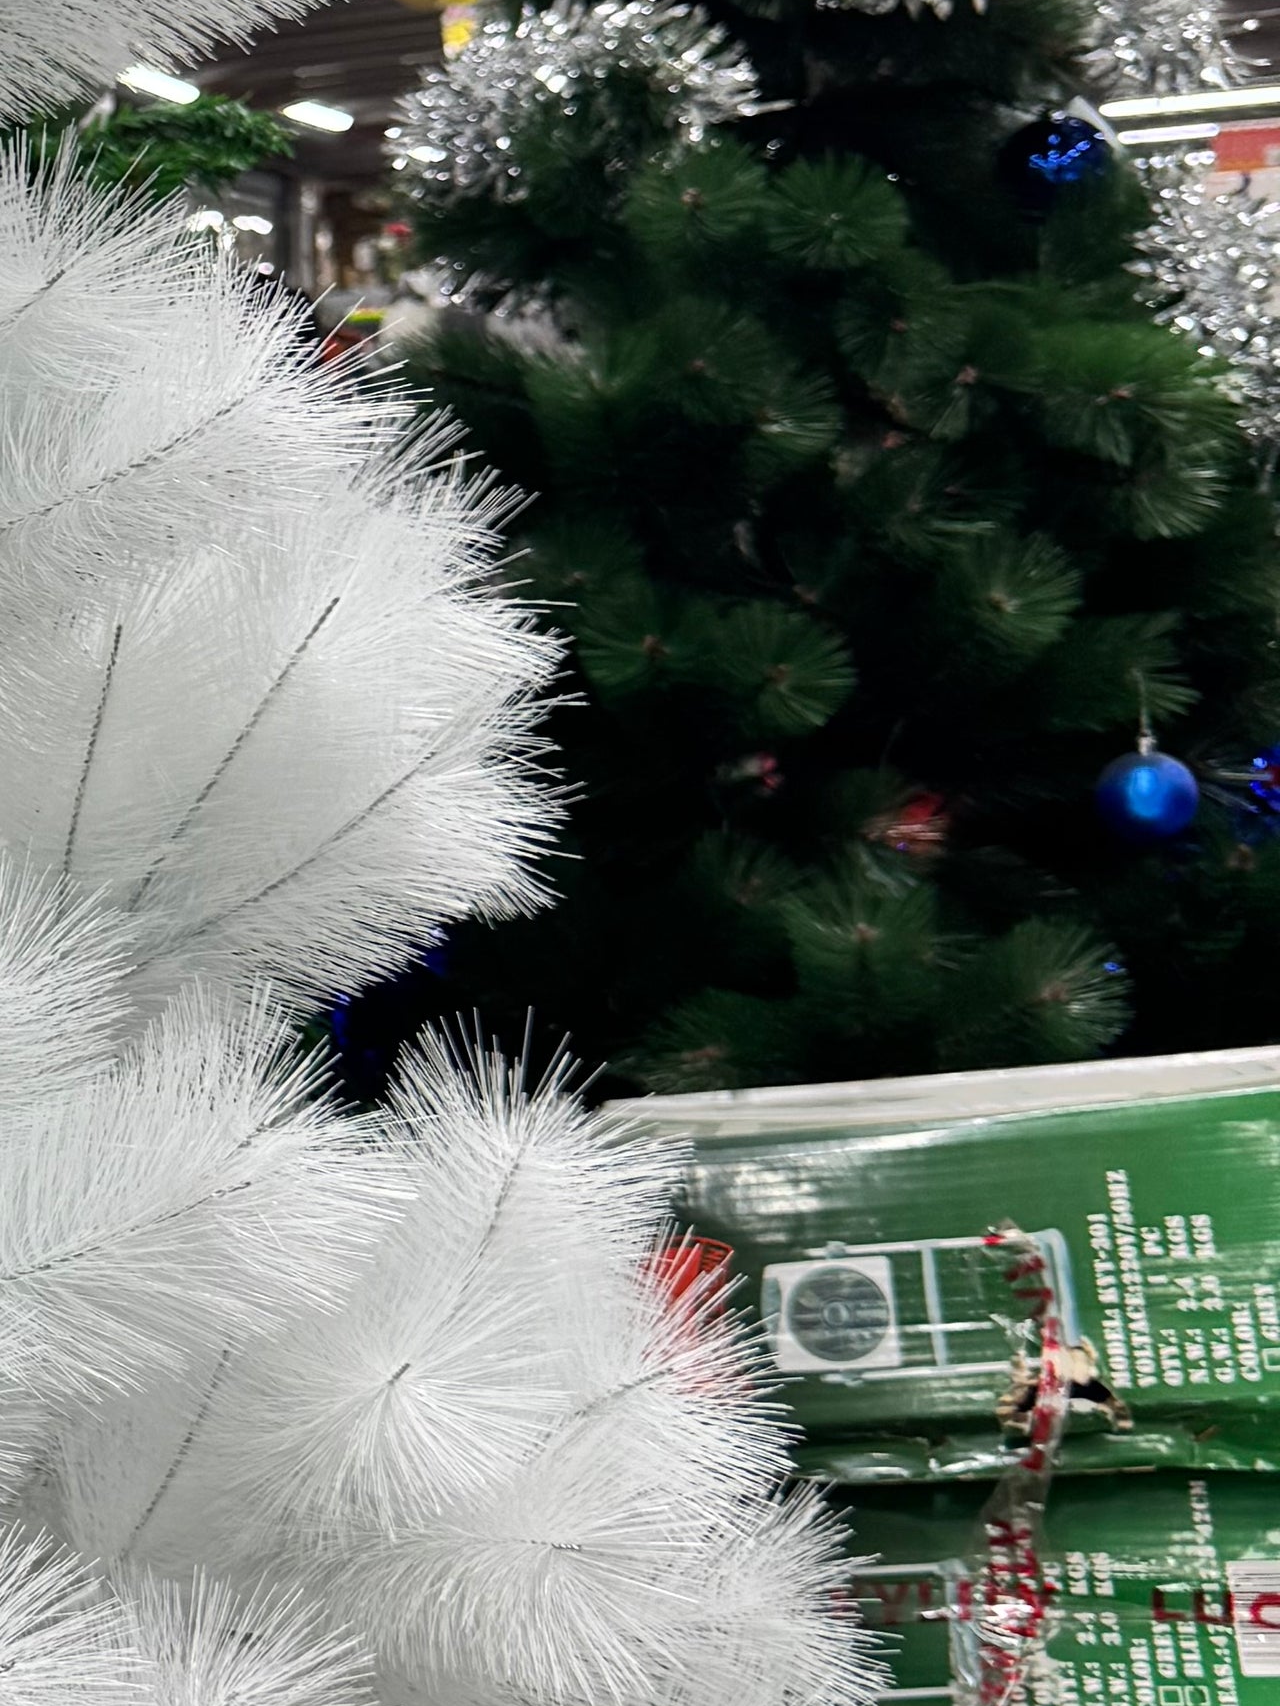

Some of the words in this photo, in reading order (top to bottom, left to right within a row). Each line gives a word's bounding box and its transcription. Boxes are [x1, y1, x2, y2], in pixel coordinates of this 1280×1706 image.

[1140, 1226, 1164, 1256] PC
[1164, 1215, 1191, 1259] KGS
[1190, 1214, 1217, 1258] KGS
[1231, 1301, 1262, 1381] COLOR:
